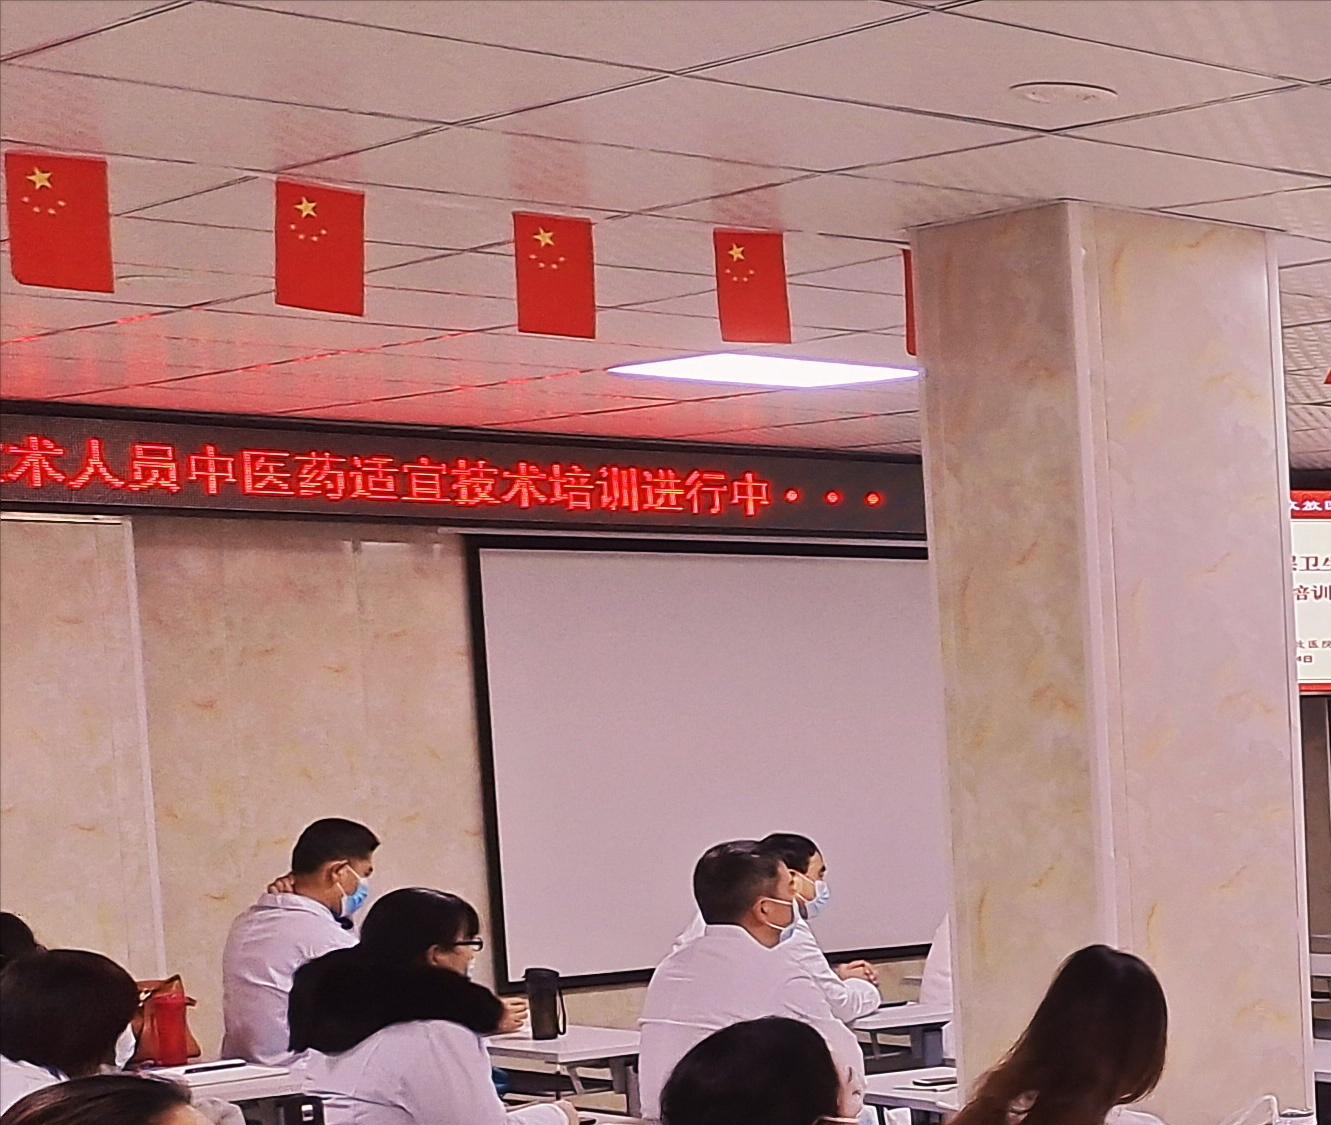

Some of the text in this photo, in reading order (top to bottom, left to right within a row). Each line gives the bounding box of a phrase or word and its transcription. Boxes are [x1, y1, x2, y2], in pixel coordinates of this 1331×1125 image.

[0, 435, 884, 518] 术人员中医药适宜技术培训进行中···
